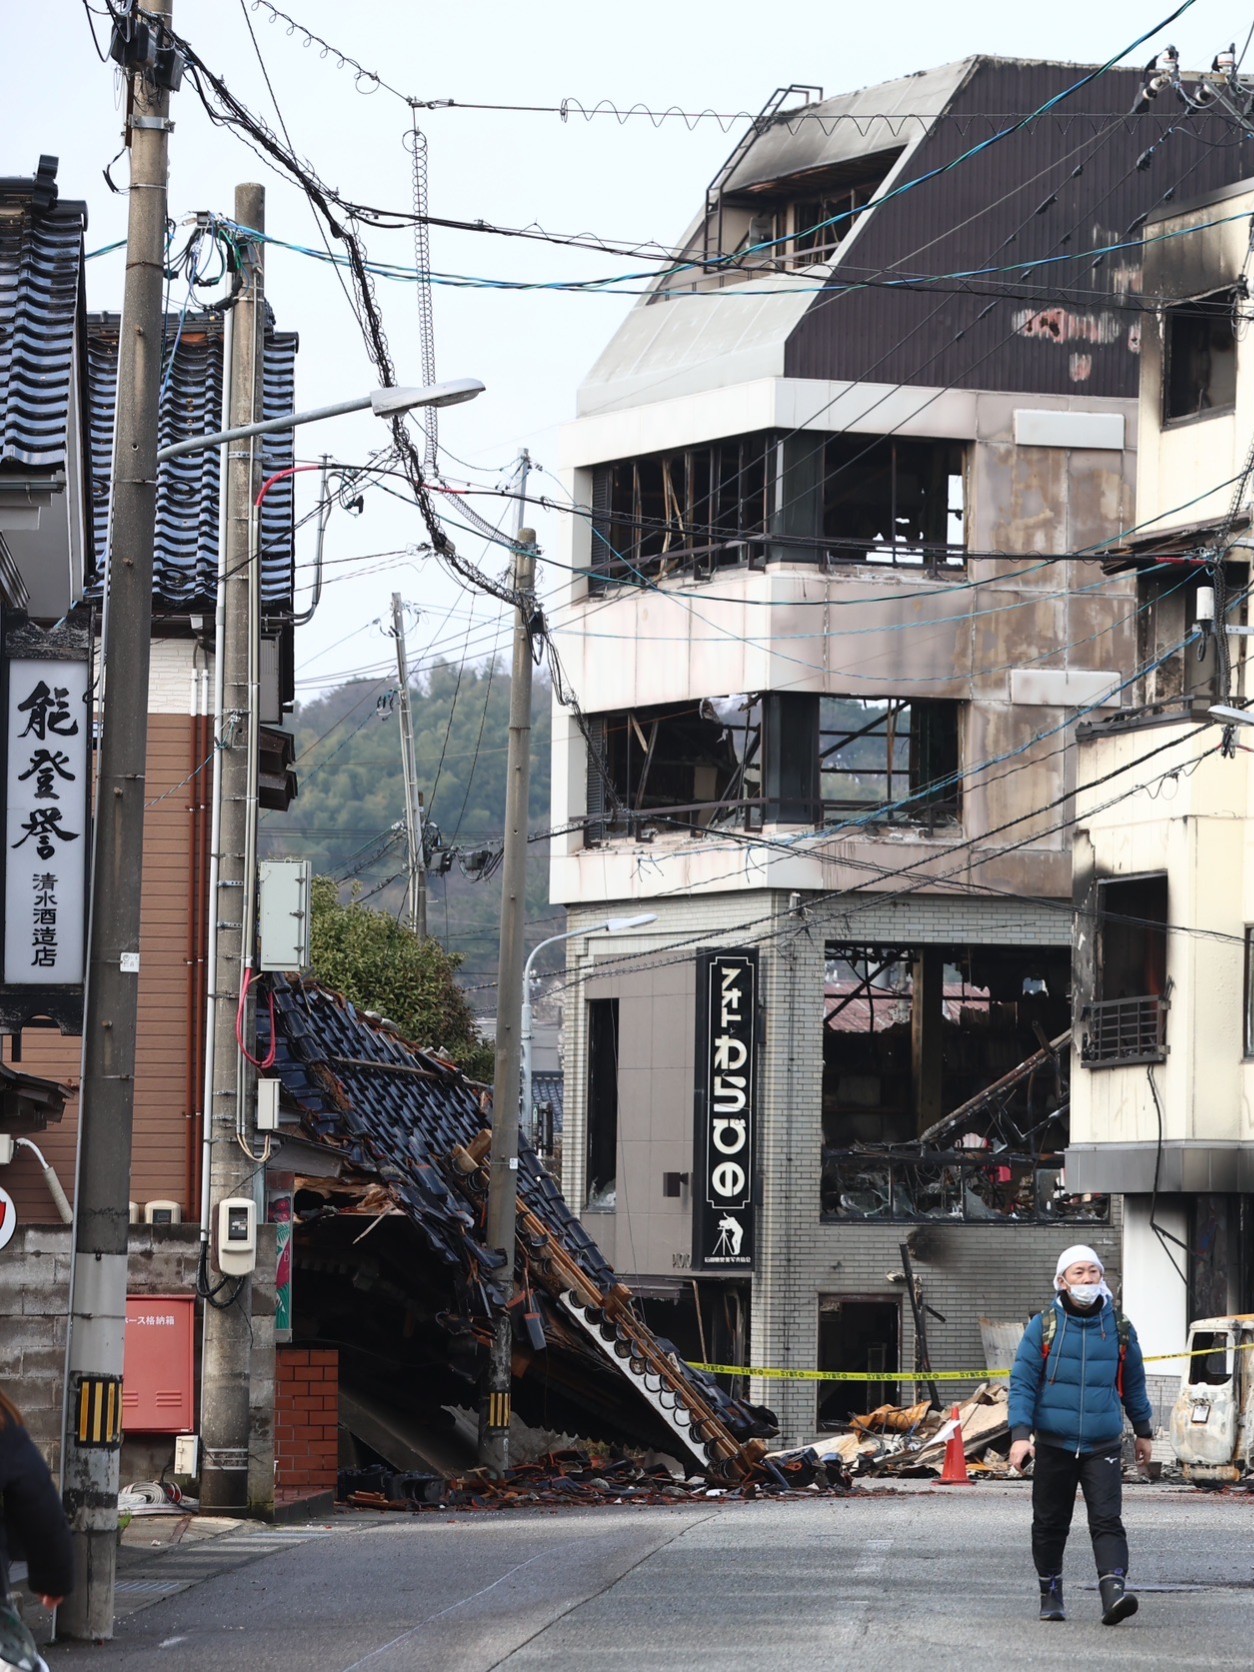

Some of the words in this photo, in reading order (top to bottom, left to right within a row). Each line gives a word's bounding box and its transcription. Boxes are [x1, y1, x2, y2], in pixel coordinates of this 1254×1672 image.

[11, 680, 81, 860] 能登誉
[31, 872, 58, 967] 清水酒造店
